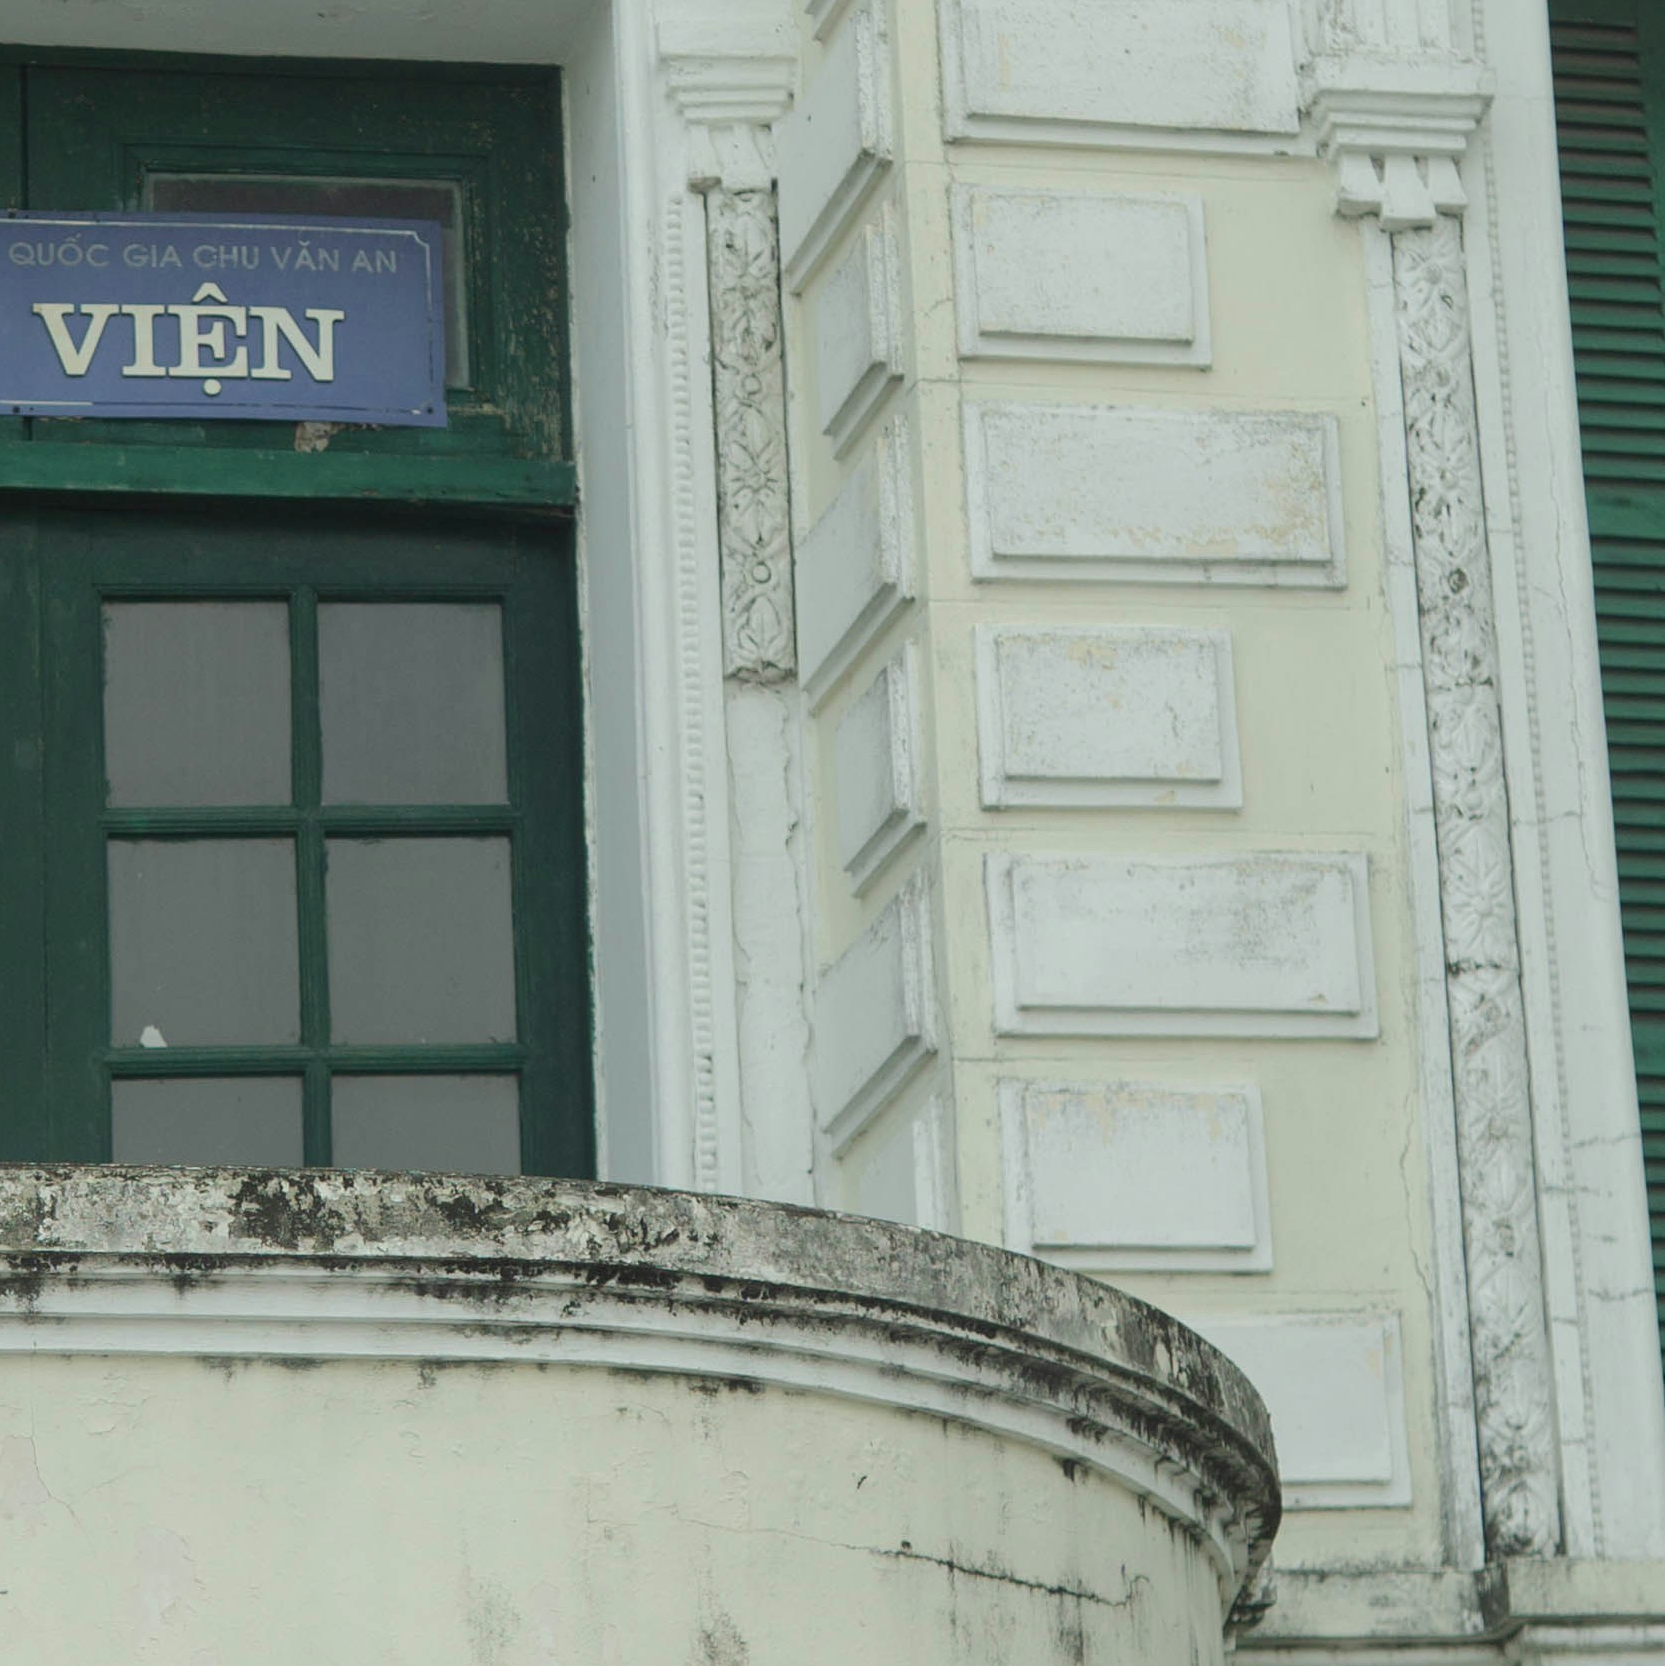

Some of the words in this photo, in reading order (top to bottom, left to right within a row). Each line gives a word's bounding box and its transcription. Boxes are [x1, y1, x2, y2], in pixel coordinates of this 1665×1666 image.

[8, 232, 110, 268] QUỐC
[123, 243, 182, 269] GIA
[193, 244, 260, 271] CHU
[270, 241, 340, 272] VĂN
[351, 249, 398, 274] AN
[32, 281, 346, 397] VIỆN
